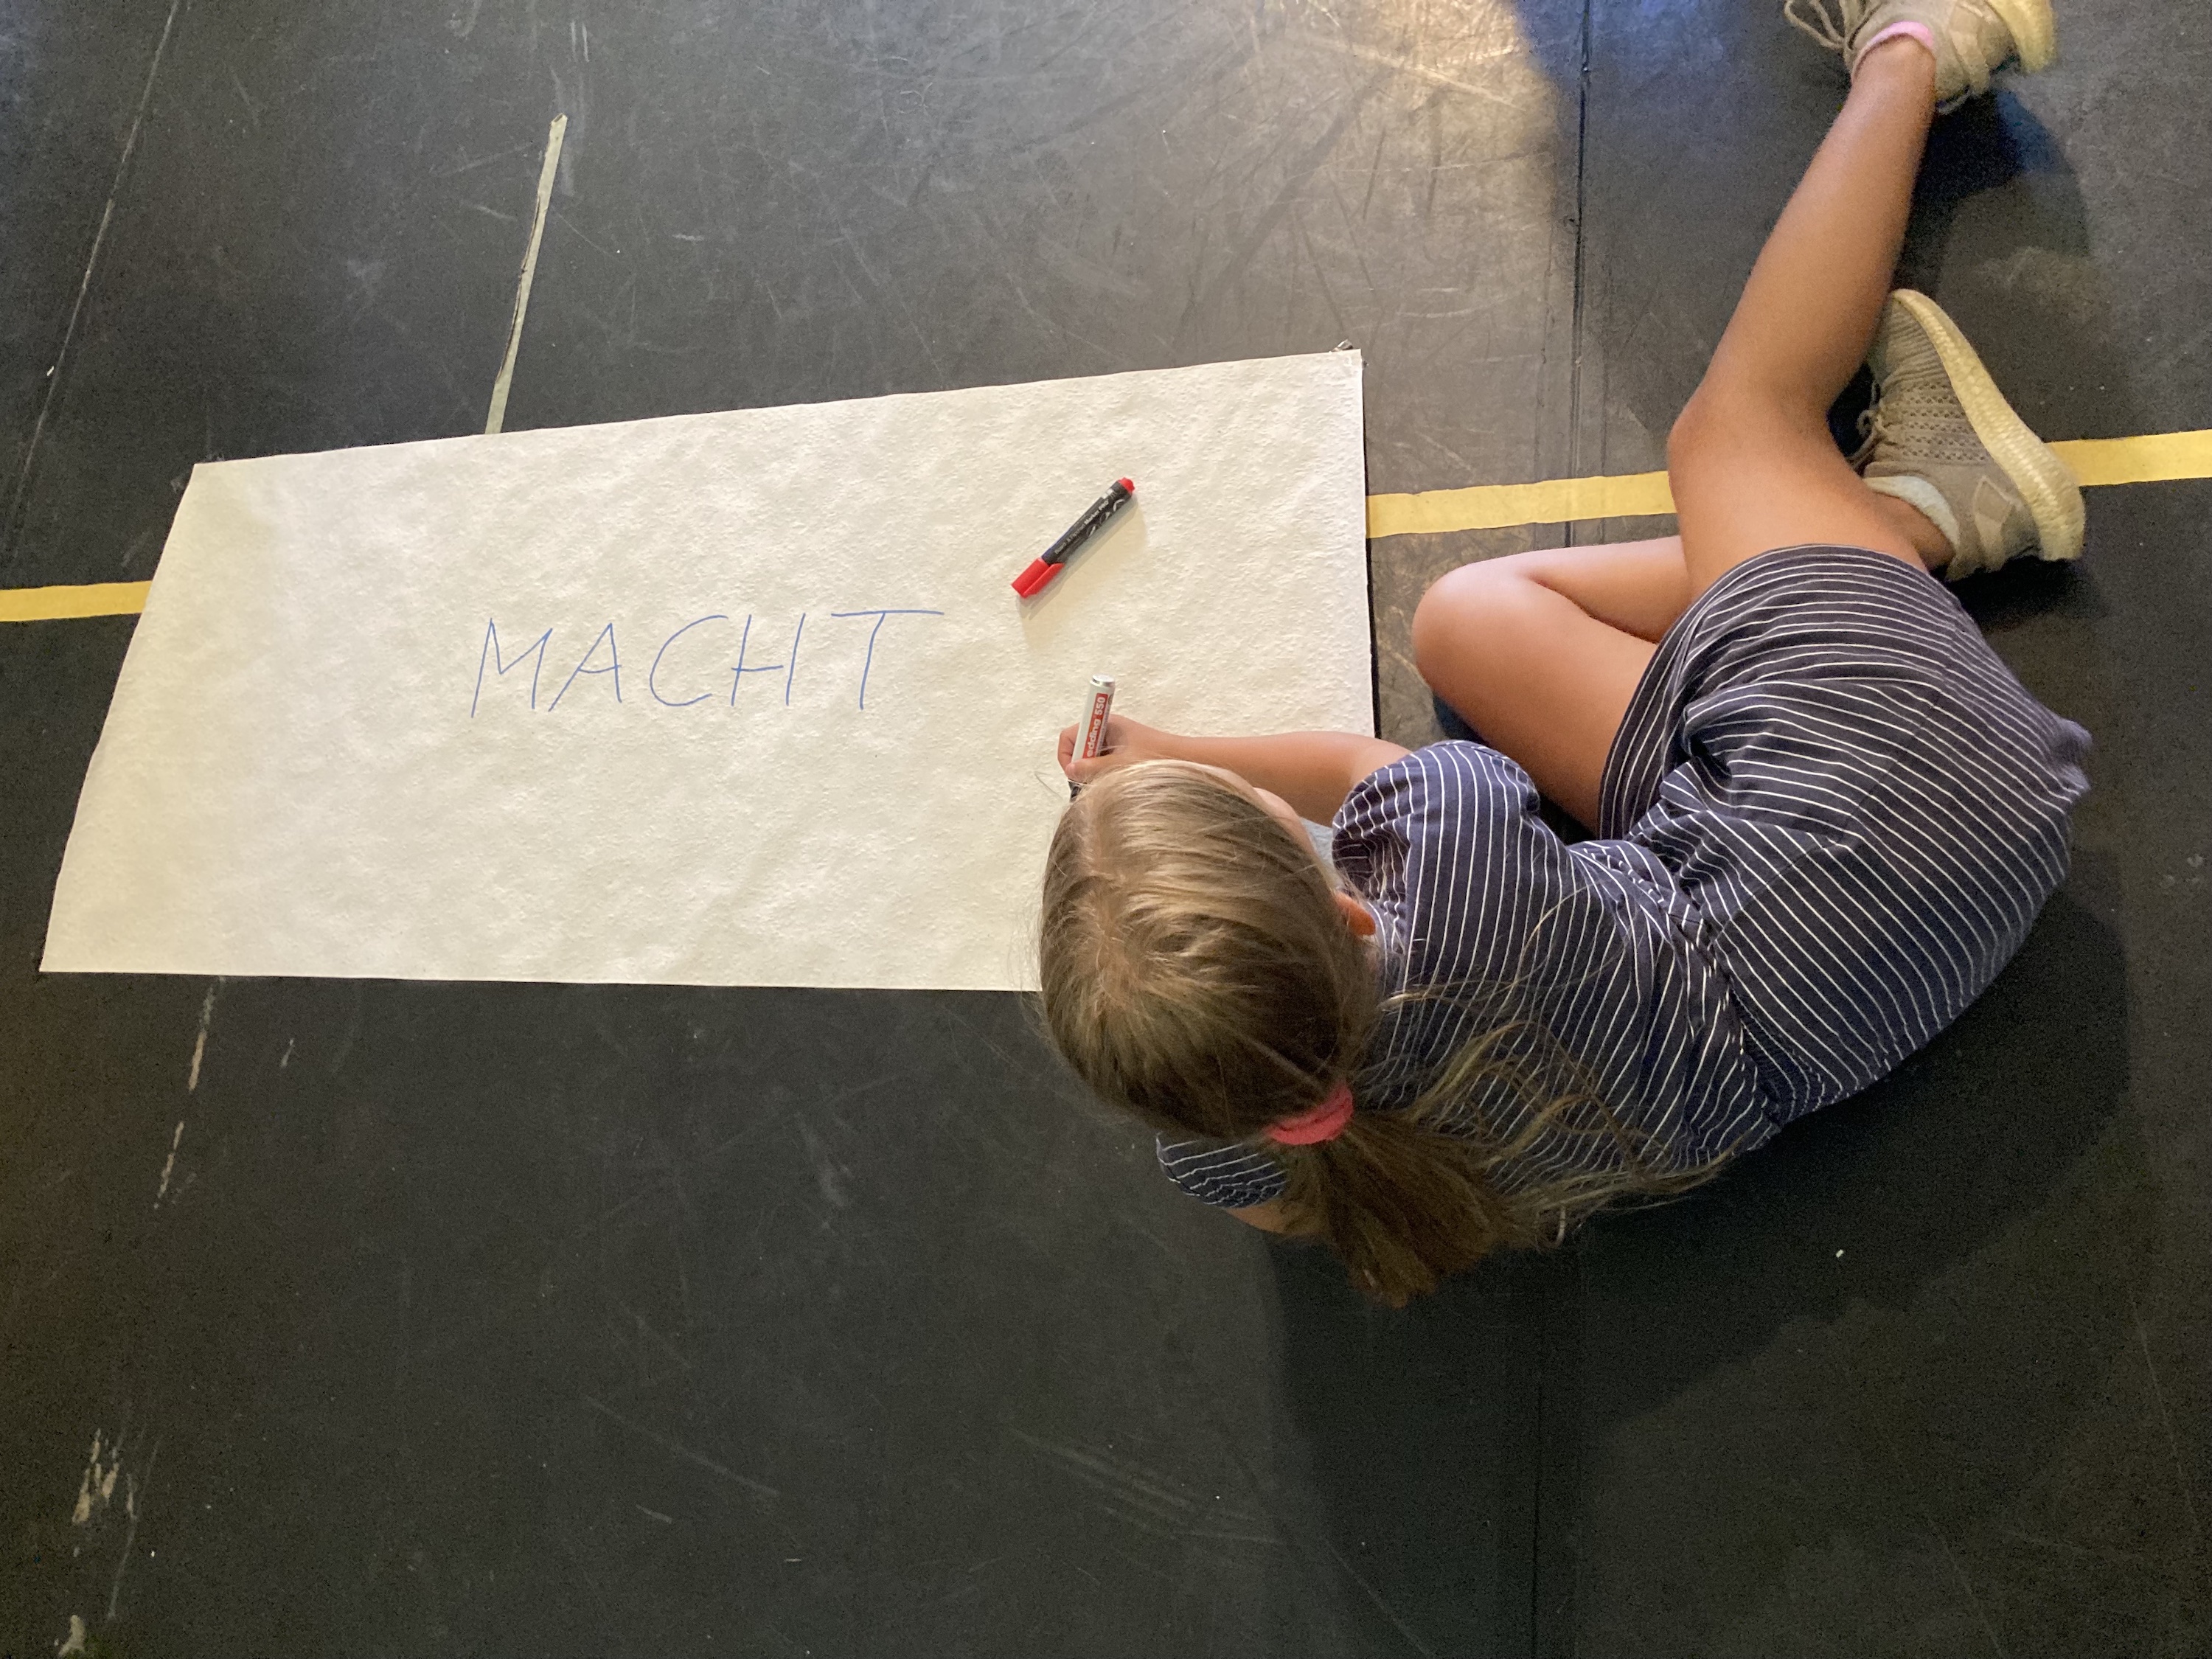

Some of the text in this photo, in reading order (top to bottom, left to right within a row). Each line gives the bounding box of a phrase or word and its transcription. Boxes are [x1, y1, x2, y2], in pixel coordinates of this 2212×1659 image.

[1084, 510, 1099, 525] Marker
[471, 610, 945, 718] MACHT
[1094, 697, 1106, 715] 550
[1087, 718, 1102, 757] edding
